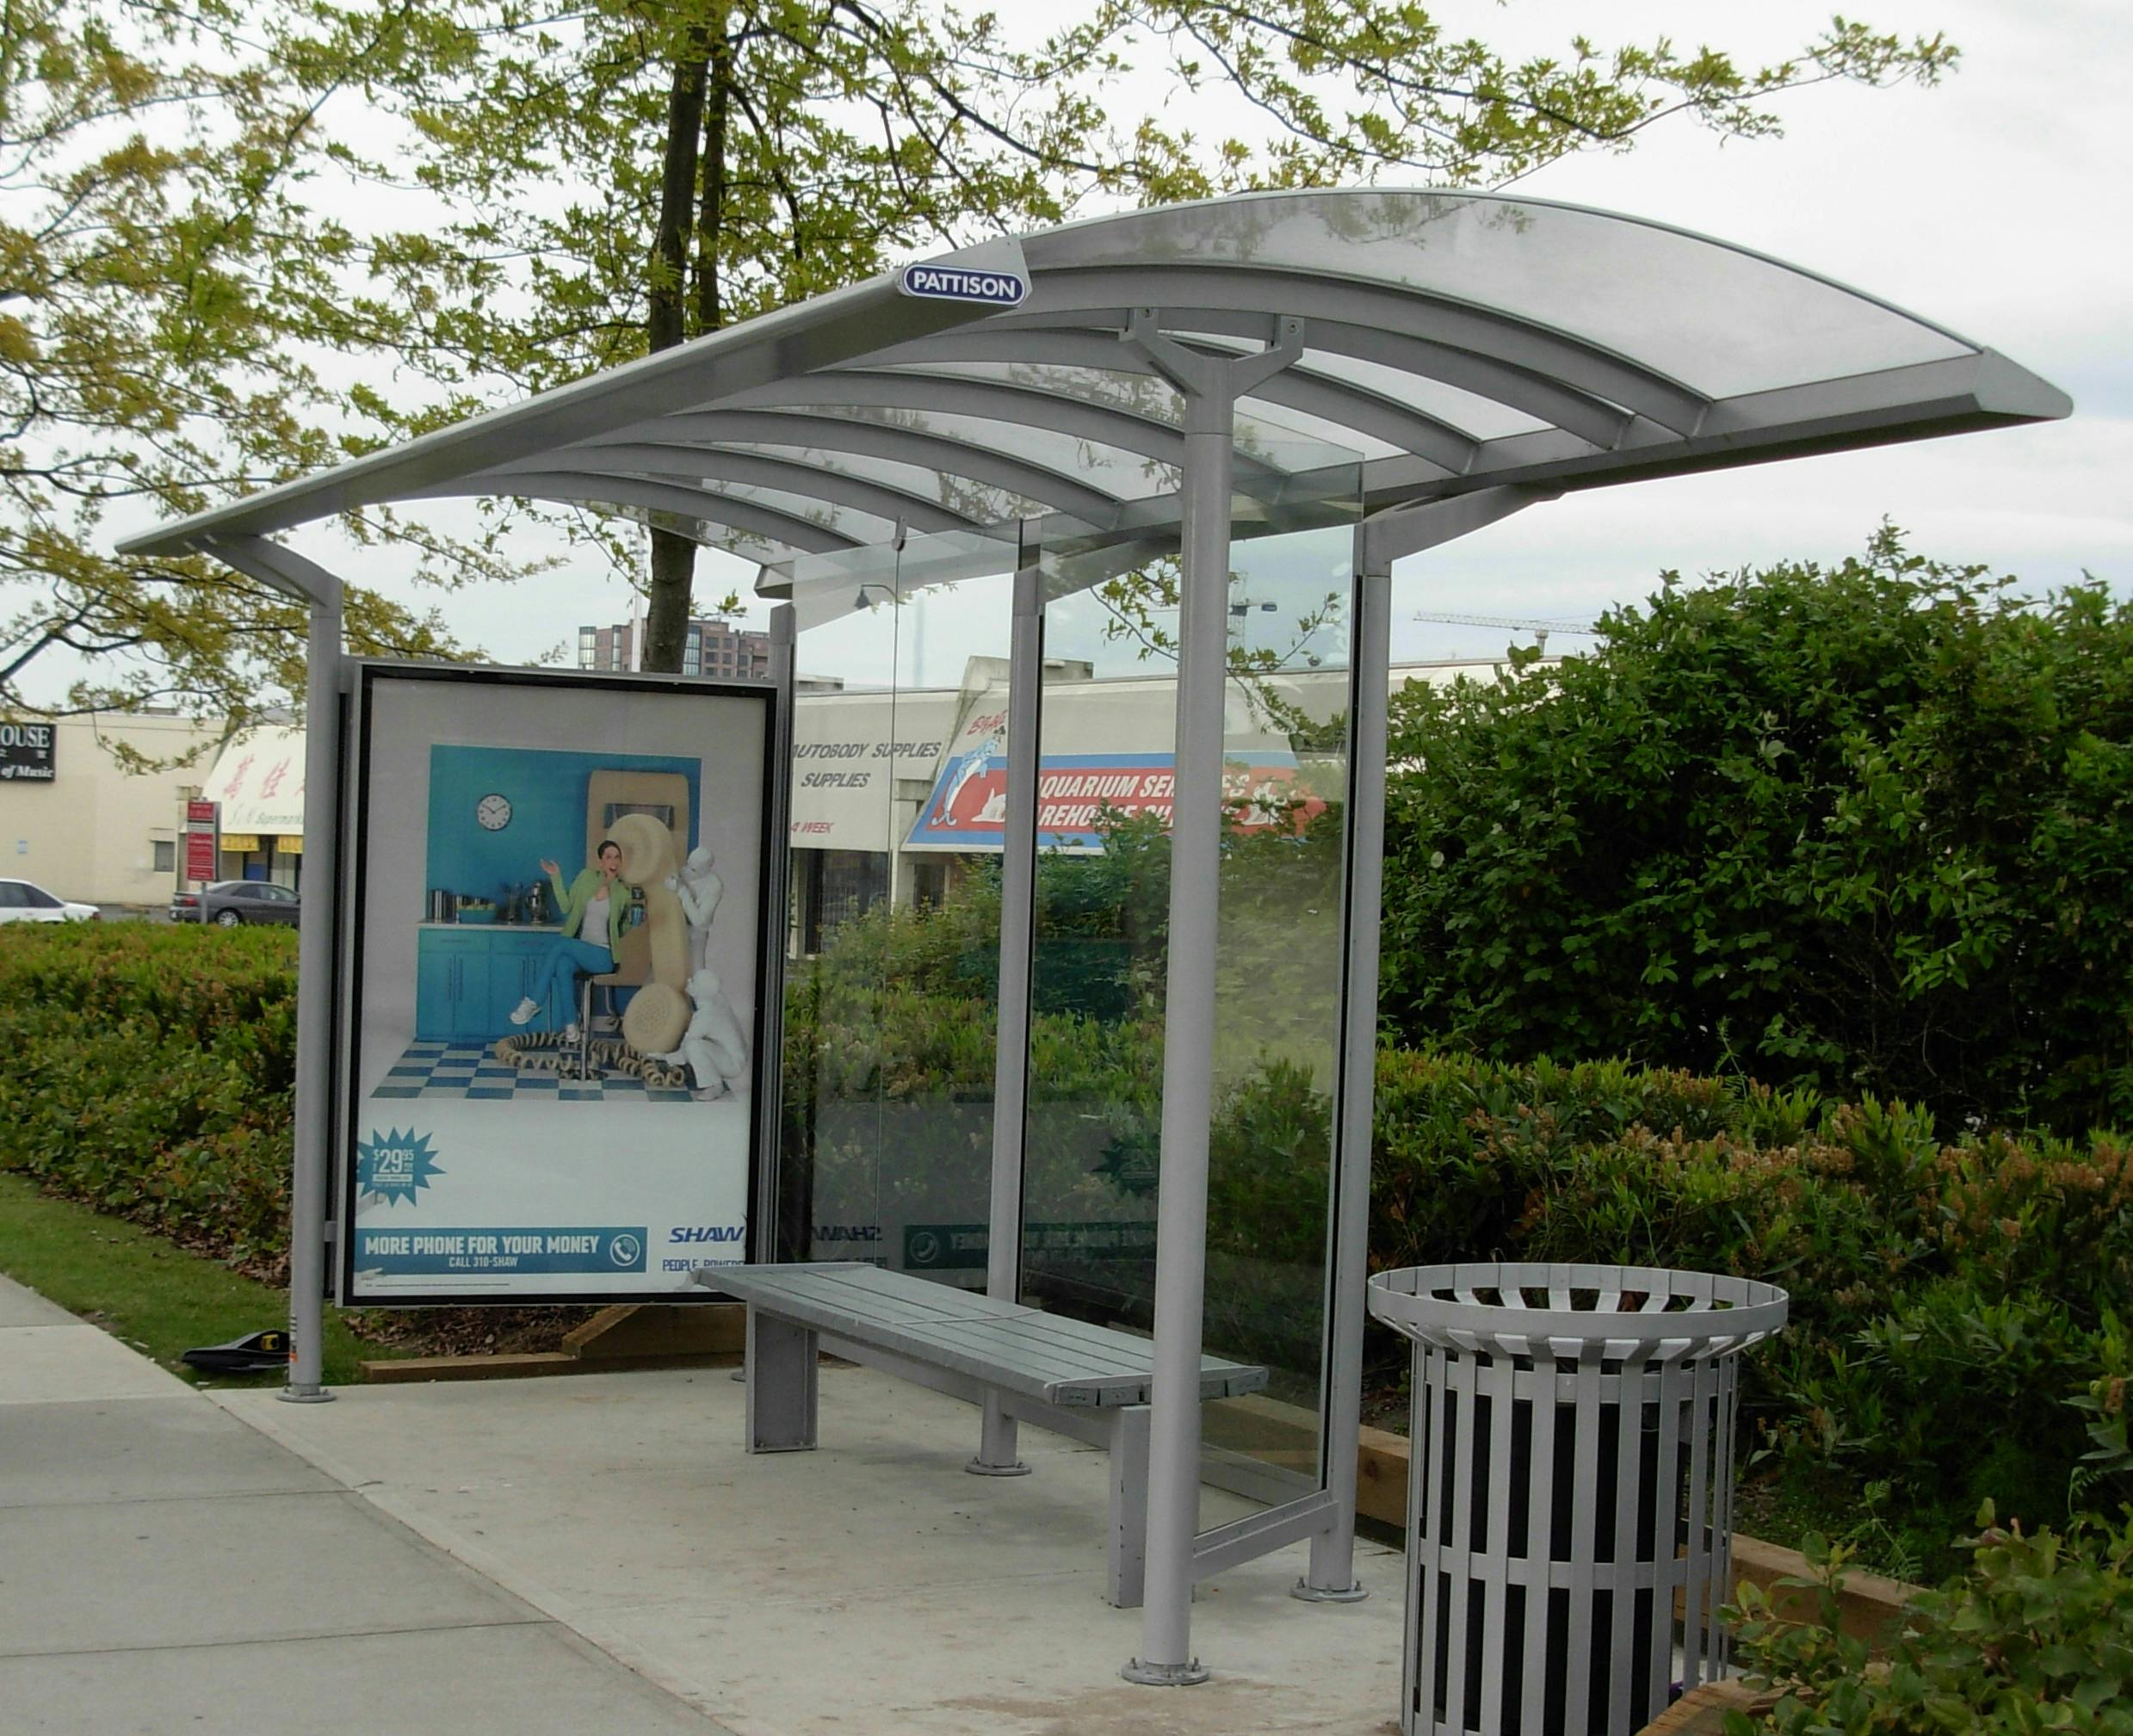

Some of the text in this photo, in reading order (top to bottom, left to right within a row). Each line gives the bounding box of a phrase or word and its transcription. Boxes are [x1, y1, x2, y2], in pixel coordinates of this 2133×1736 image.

[913, 271, 1016, 299] PATTISON
[0, 726, 50, 748] OUSE
[871, 742, 942, 758] SUPPLIES
[16, 765, 53, 778] Music
[801, 773, 871, 788] SUPPLIES
[1039, 775, 1140, 799] QUARIUM
[801, 822, 834, 833] WEEK
[669, 1226, 745, 1242] SHAW
[365, 1235, 600, 1254] MORE PHONE FOR YOUR MONEY
[448, 1256, 518, 1268] CALL 310-SHAW
[663, 1259, 698, 1271] PEOPLE
